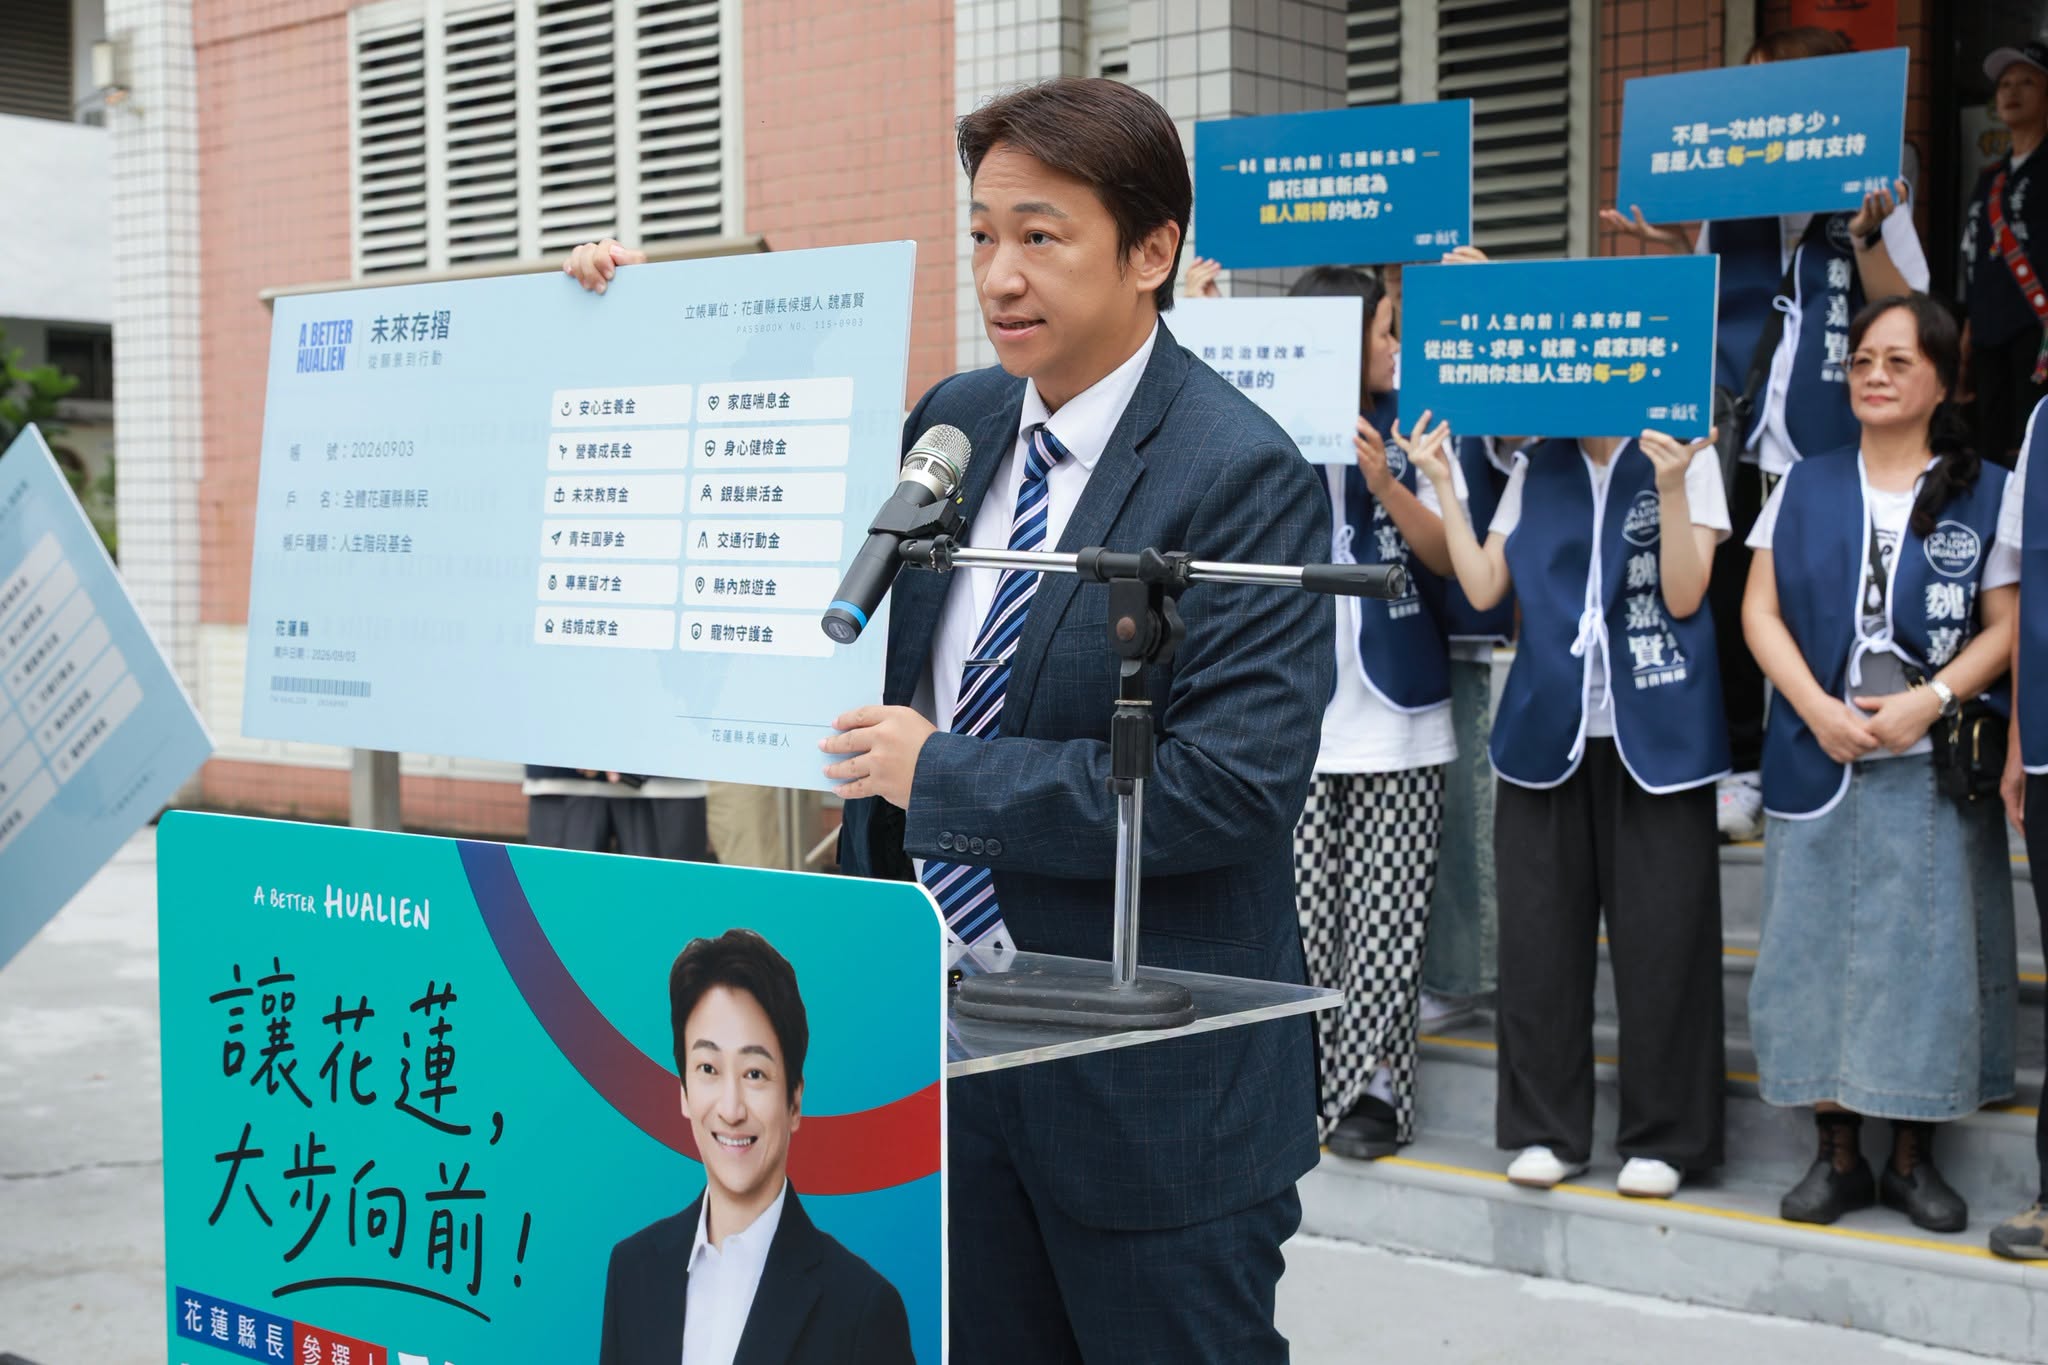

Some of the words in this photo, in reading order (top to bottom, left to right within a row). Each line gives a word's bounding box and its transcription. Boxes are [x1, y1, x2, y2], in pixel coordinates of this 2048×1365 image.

[1651, 133, 1867, 175] 而是人生每一步都有支持
[828, 292, 865, 309] 魏嘉賢
[370, 310, 450, 344] 未來存摺
[736, 322, 783, 334] PASSBOOK
[1461, 314, 1478, 331] 01
[1487, 313, 1552, 331] 人生向前
[1572, 311, 1642, 329] 未來存摺
[299, 322, 307, 347] A
[311, 319, 353, 347] BETTER
[297, 346, 346, 373] HUALIEN
[1439, 362, 1661, 385] 我們陪你走過人生的每一步。
[579, 398, 636, 416] 安心生養金
[727, 392, 791, 411] 家庭喘息金
[575, 442, 633, 459] 營養成長金
[724, 438, 787, 457] 身心健檢金
[571, 487, 629, 504] 未來教育金
[720, 485, 784, 503] 銀髮樂活金
[568, 531, 626, 547] 青年圓夢金
[717, 531, 780, 549] 交通行動金
[565, 575, 622, 592] 專業留才金
[713, 578, 777, 596] 縣內旅遊金
[561, 618, 619, 637] 結婚成家金
[710, 624, 774, 643] 寵物守護金
[712, 729, 790, 748] 花蓮縣長候選人
[254, 885, 266, 906] A
[270, 888, 316, 914] BETTER
[324, 884, 430, 930] HUALIEN
[184, 1298, 284, 1359] 花蓮縣長
